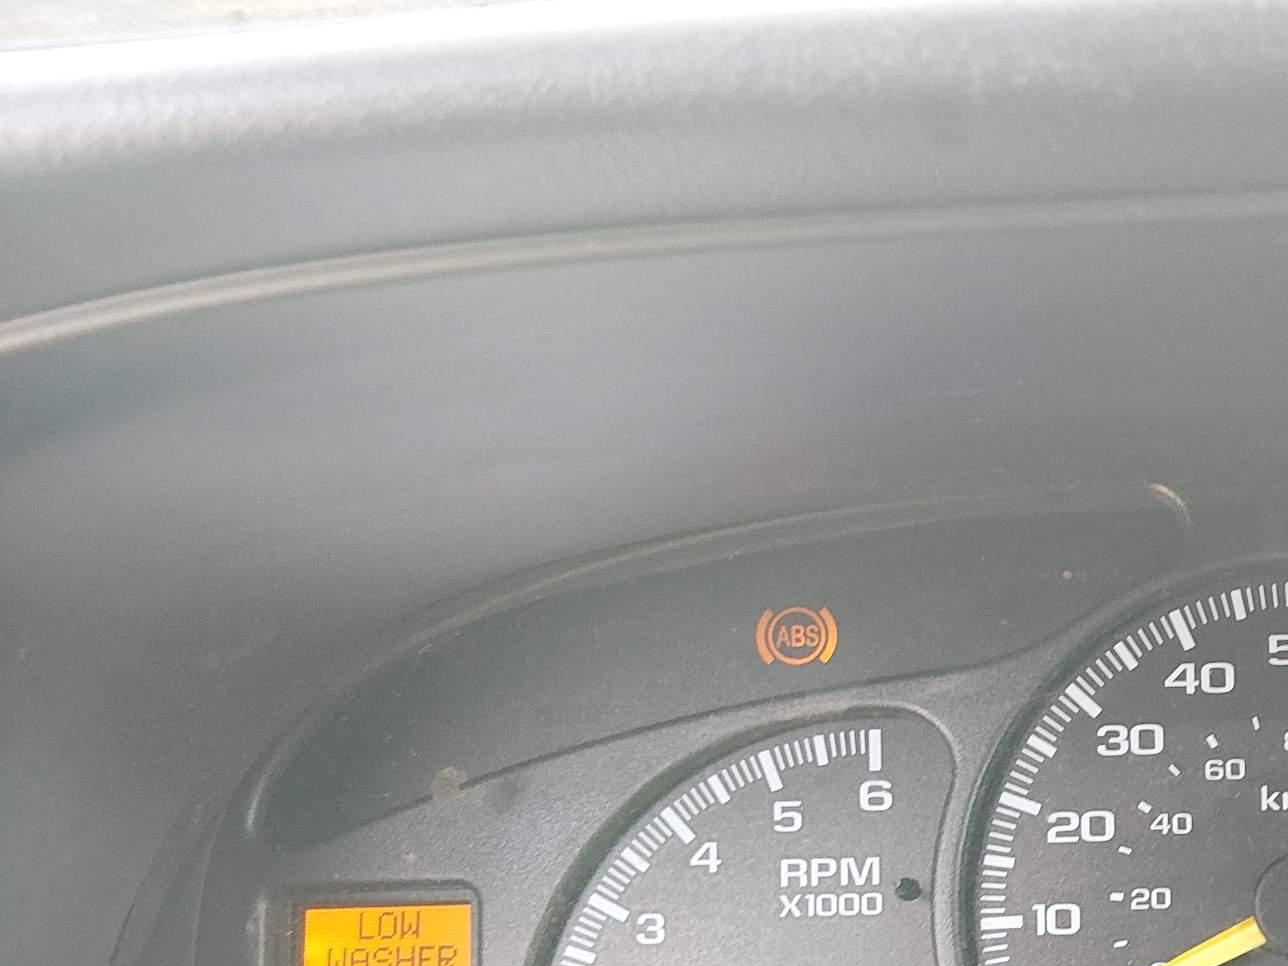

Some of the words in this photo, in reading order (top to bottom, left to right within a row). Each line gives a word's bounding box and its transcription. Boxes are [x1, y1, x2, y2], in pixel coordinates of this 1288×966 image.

[776, 624, 820, 648] ABS
[1165, 663, 1234, 694] 40
[1097, 724, 1163, 755] 30
[1205, 759, 1245, 780] 60
[860, 781, 892, 810] 6
[774, 801, 801, 831] 5
[1048, 811, 1114, 843] 20
[1151, 813, 1191, 834] 40
[689, 842, 722, 874] 4
[781, 857, 879, 887] RPM
[780, 893, 882, 917] X1000
[1131, 888, 1170, 909] 20
[359, 911, 420, 939] LOW
[637, 914, 664, 944] 3
[1032, 904, 1080, 935] 10
